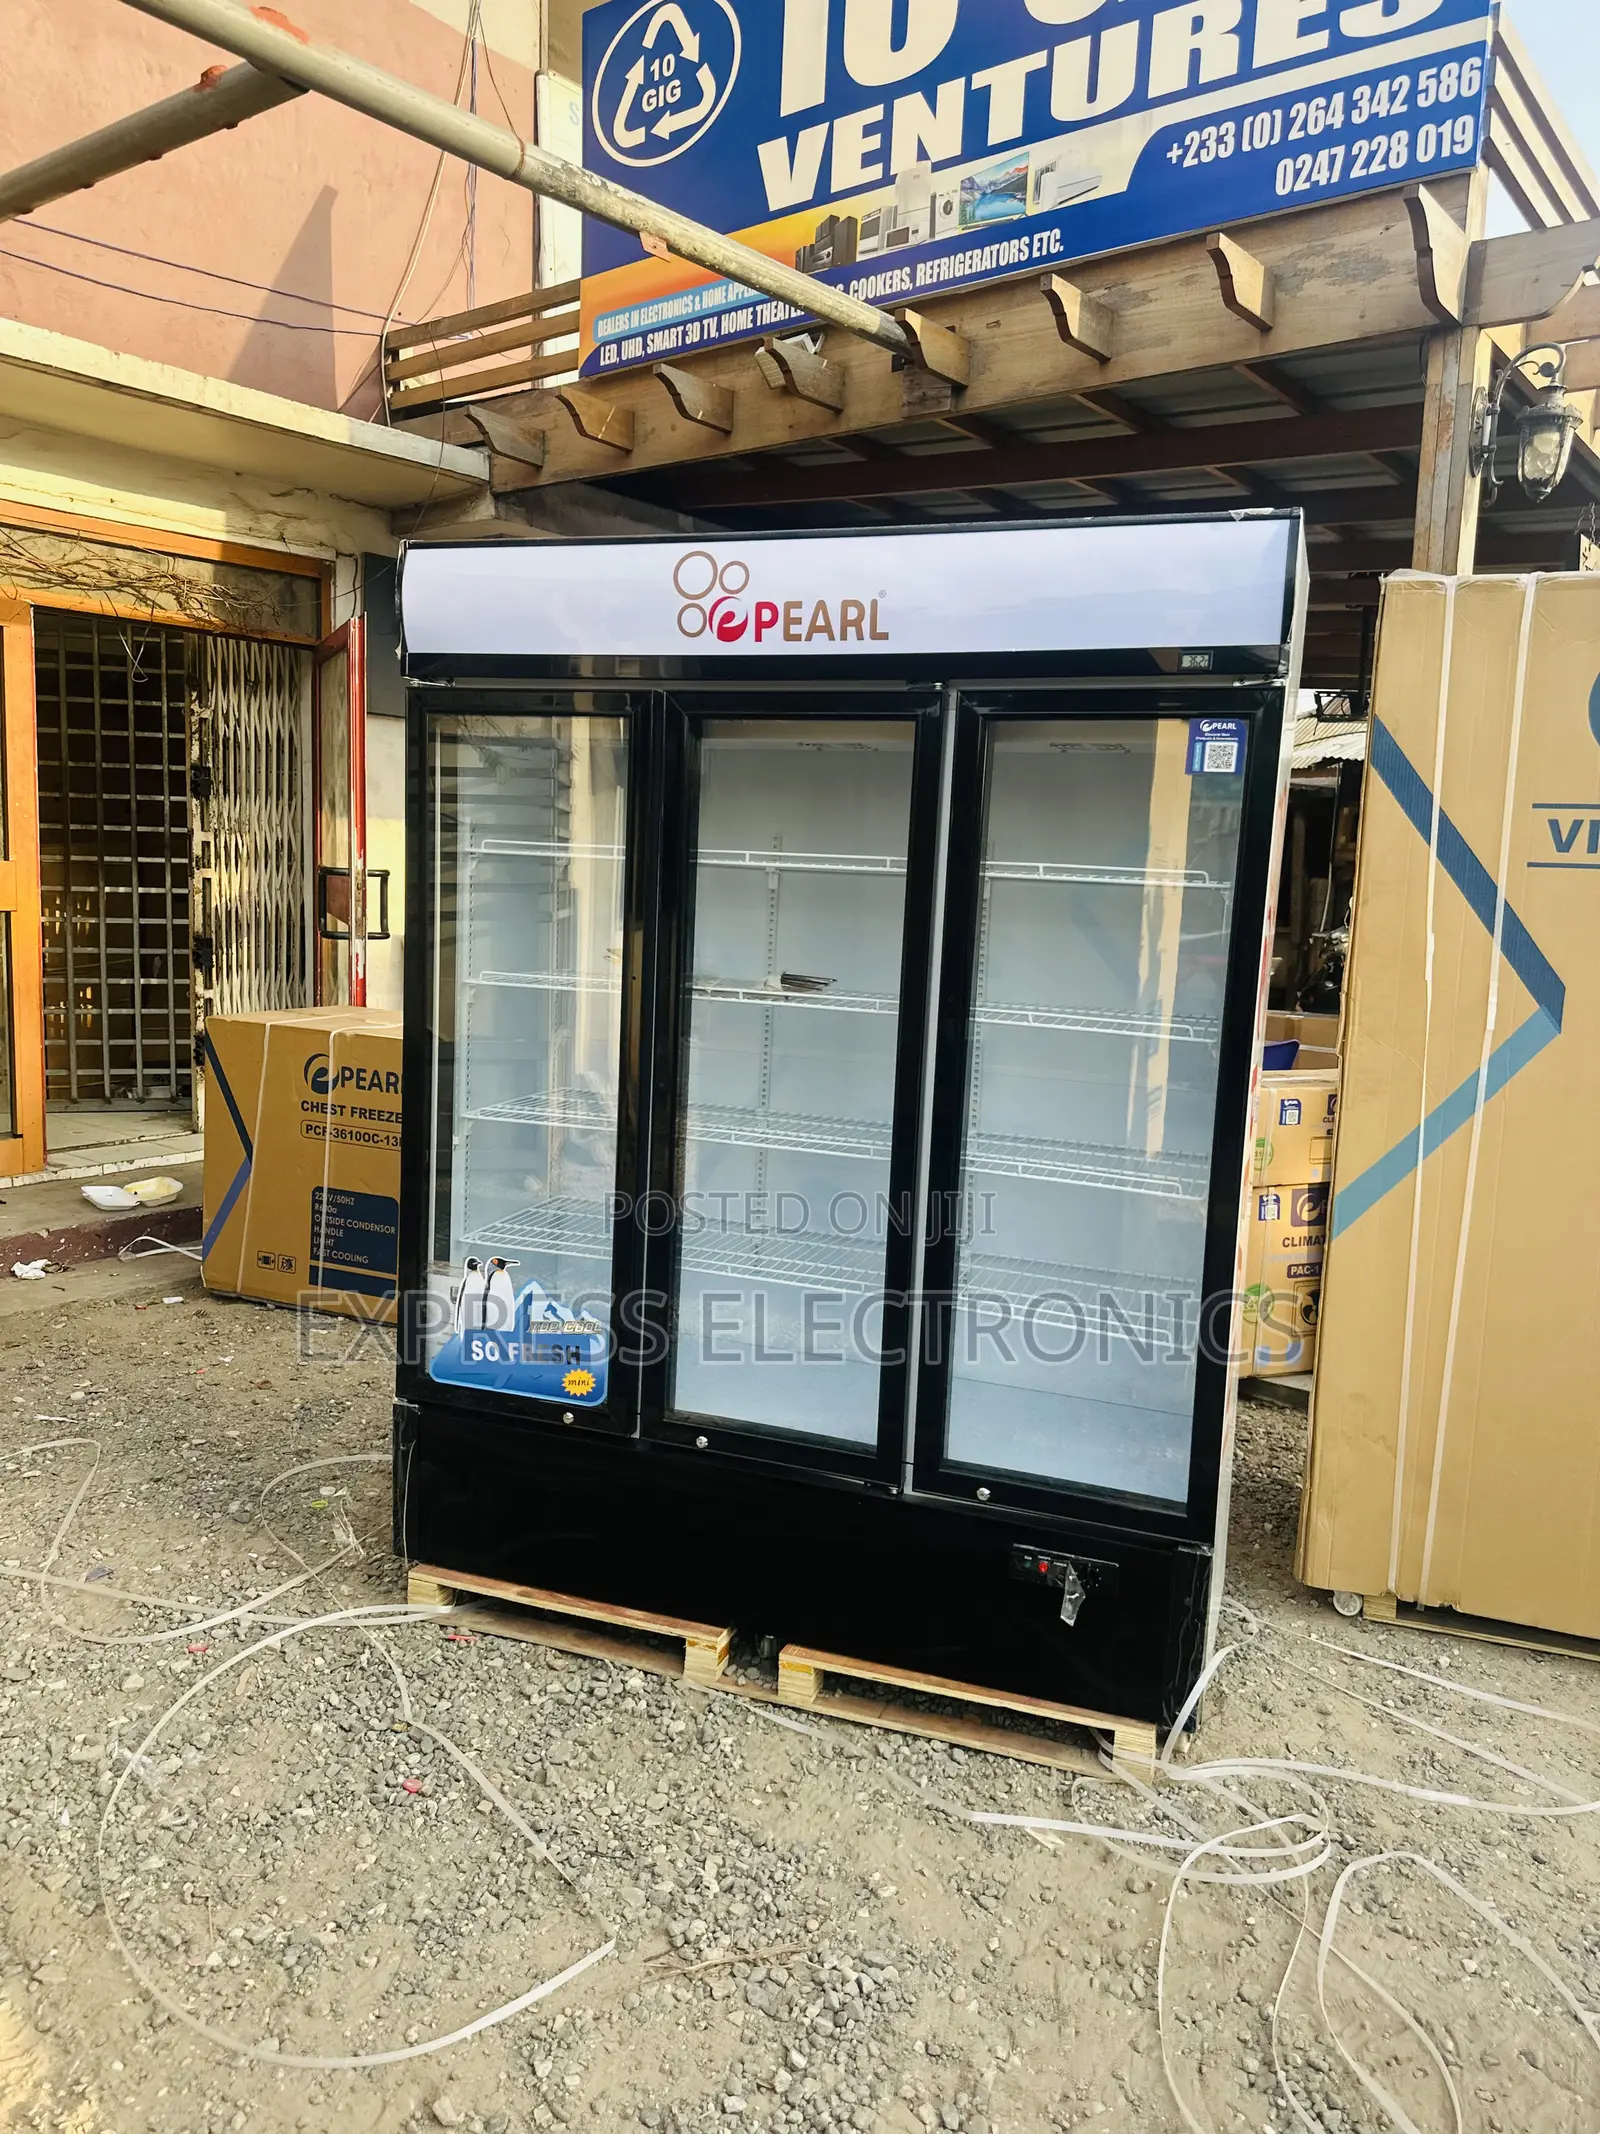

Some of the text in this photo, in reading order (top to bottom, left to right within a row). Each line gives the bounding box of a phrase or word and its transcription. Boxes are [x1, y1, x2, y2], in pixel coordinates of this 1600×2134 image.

[649, 54, 675, 83] 10
[641, 80, 682, 113] GIG
[1166, 121, 1235, 169] +233
[1288, 93, 1344, 143] 264
[1352, 75, 1410, 124] 342
[1416, 57, 1482, 108] 586
[1275, 116, 1474, 196] 0247 228 019
[848, 228, 1063, 300] COOKERS, REFRIGERATORS ETC.
[597, 315, 630, 338] DEALERS
[630, 313, 641, 329] IN
[640, 299, 693, 326] ELECTRONICS
[694, 295, 701, 309] &
[702, 287, 727, 309] HOME
[600, 346, 619, 366] LED,
[621, 339, 645, 361] UHD,
[646, 327, 684, 354] SMART
[685, 323, 701, 343] 3D
[702, 318, 719, 340] TV,
[720, 310, 753, 336] HOME
[754, 598, 889, 642] PEARL
[1212, 722, 1237, 730] PEARL
[341, 1066, 402, 1094] PEAR
[301, 1100, 346, 1117] CHEST
[314, 1202, 338, 1214] R60a
[315, 1191, 355, 1206] 22V/50HZ
[314, 1214, 396, 1235] OTSIDE CONDENSOR
[313, 1236, 334, 1246] LIHT
[331, 1250, 369, 1264] COOLING
[529, 1320, 603, 1334] TOP COOL
[471, 1340, 581, 1366] SO FRESH
[567, 1375, 590, 1386] mini
